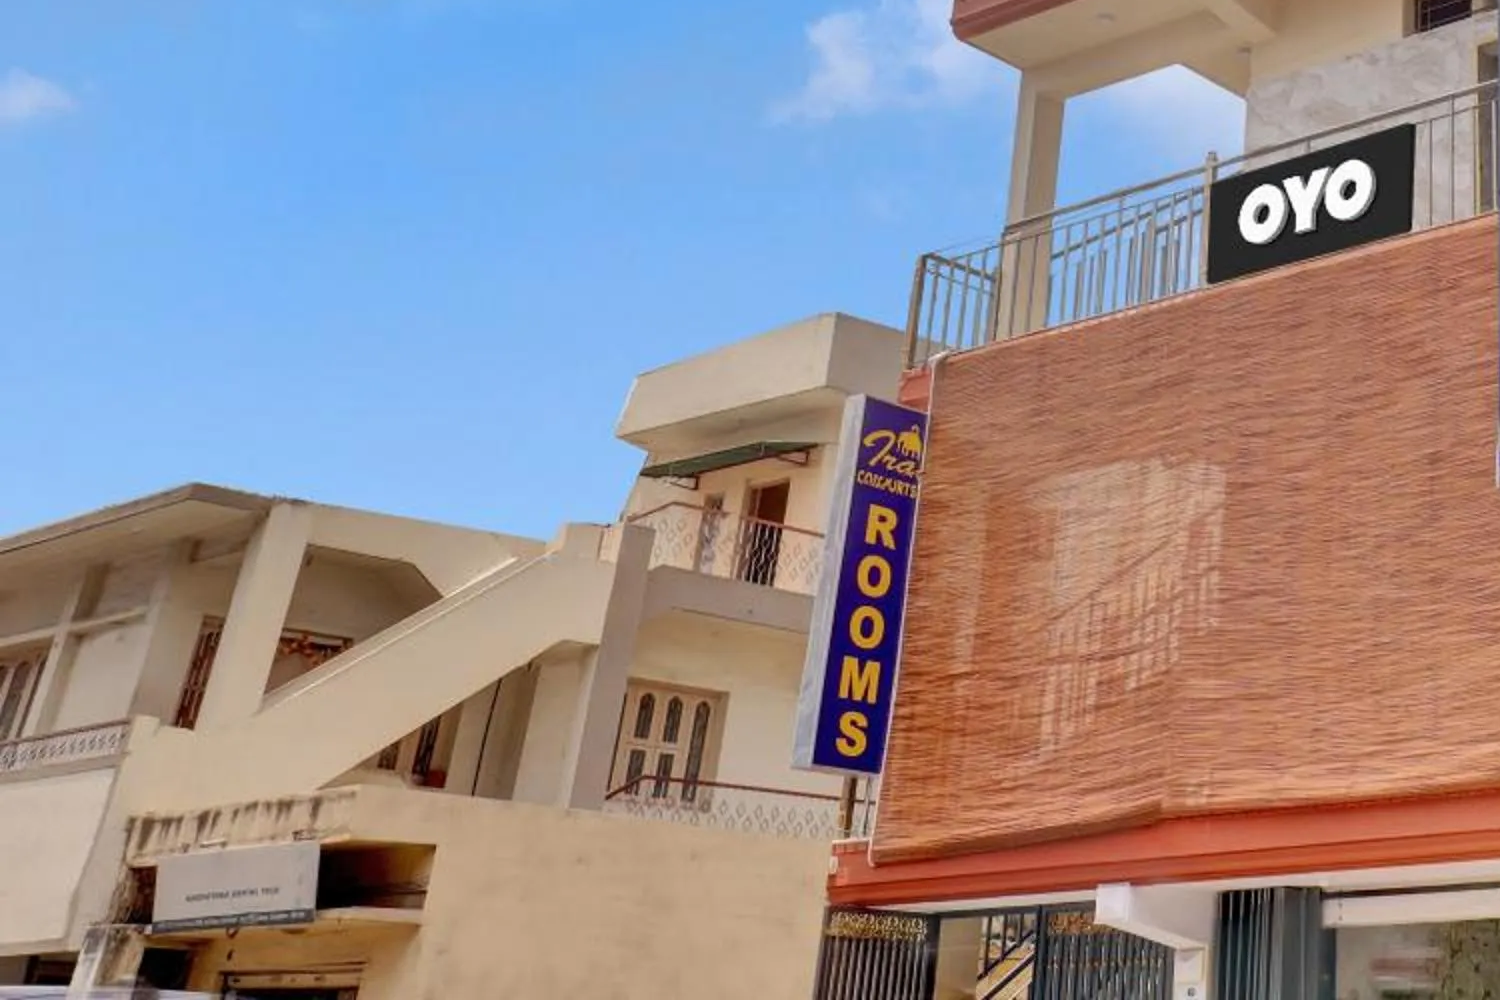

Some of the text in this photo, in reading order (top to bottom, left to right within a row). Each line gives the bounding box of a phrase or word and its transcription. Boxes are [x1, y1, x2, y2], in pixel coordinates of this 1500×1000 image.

[1238, 159, 1377, 244] OYO
[863, 429, 921, 478] Ira
[835, 503, 898, 758] ROOMS
